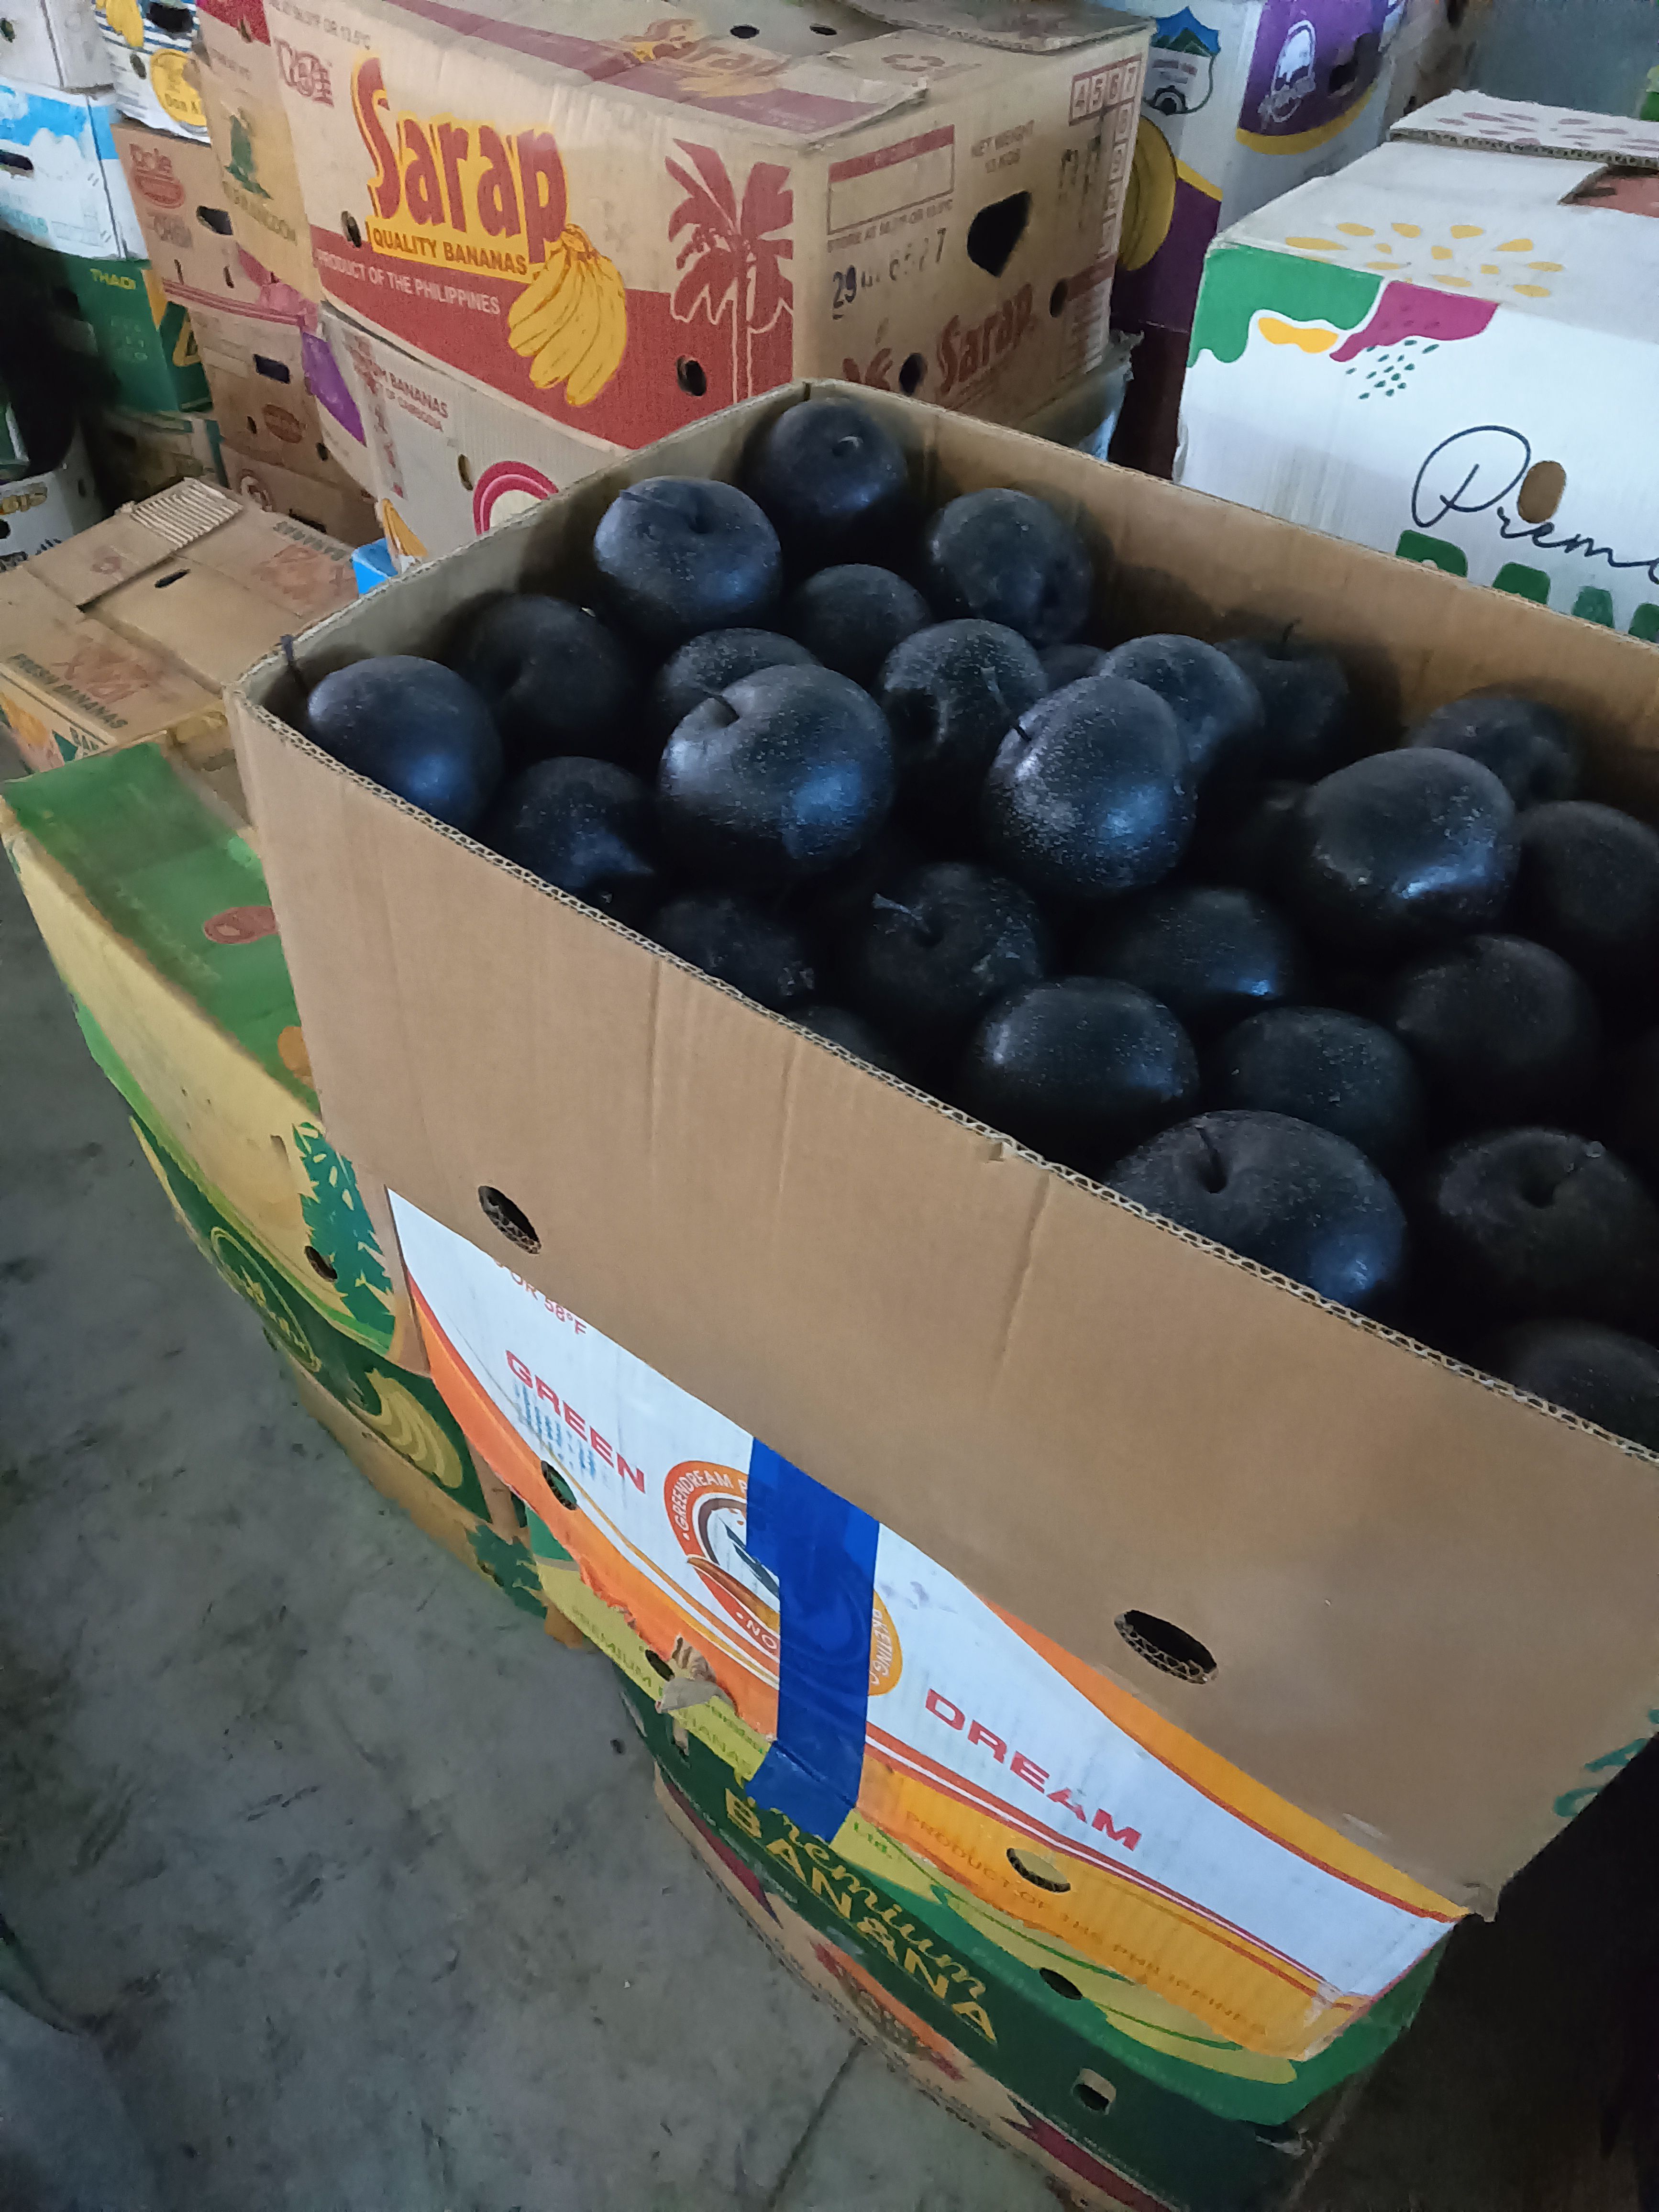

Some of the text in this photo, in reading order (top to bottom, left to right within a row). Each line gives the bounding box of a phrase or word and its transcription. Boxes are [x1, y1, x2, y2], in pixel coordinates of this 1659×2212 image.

[351, 54, 567, 264] Sarap
[313, 248, 500, 315] PRODUCT OF THE PHILIPPINES
[373, 228, 528, 276] QUALITY BANANAS
[936, 283, 1034, 395] Sarap
[389, 372, 449, 419] BANANAS
[505, 1349, 645, 1494] GREEN
[671, 1470, 734, 1531] GREENDREAM
[925, 1688, 1142, 1852] DREAM
[744, 1792, 987, 2000] remium
[906, 1810, 1010, 1889] PRODUCT
[725, 1788, 998, 2045] BANANA
